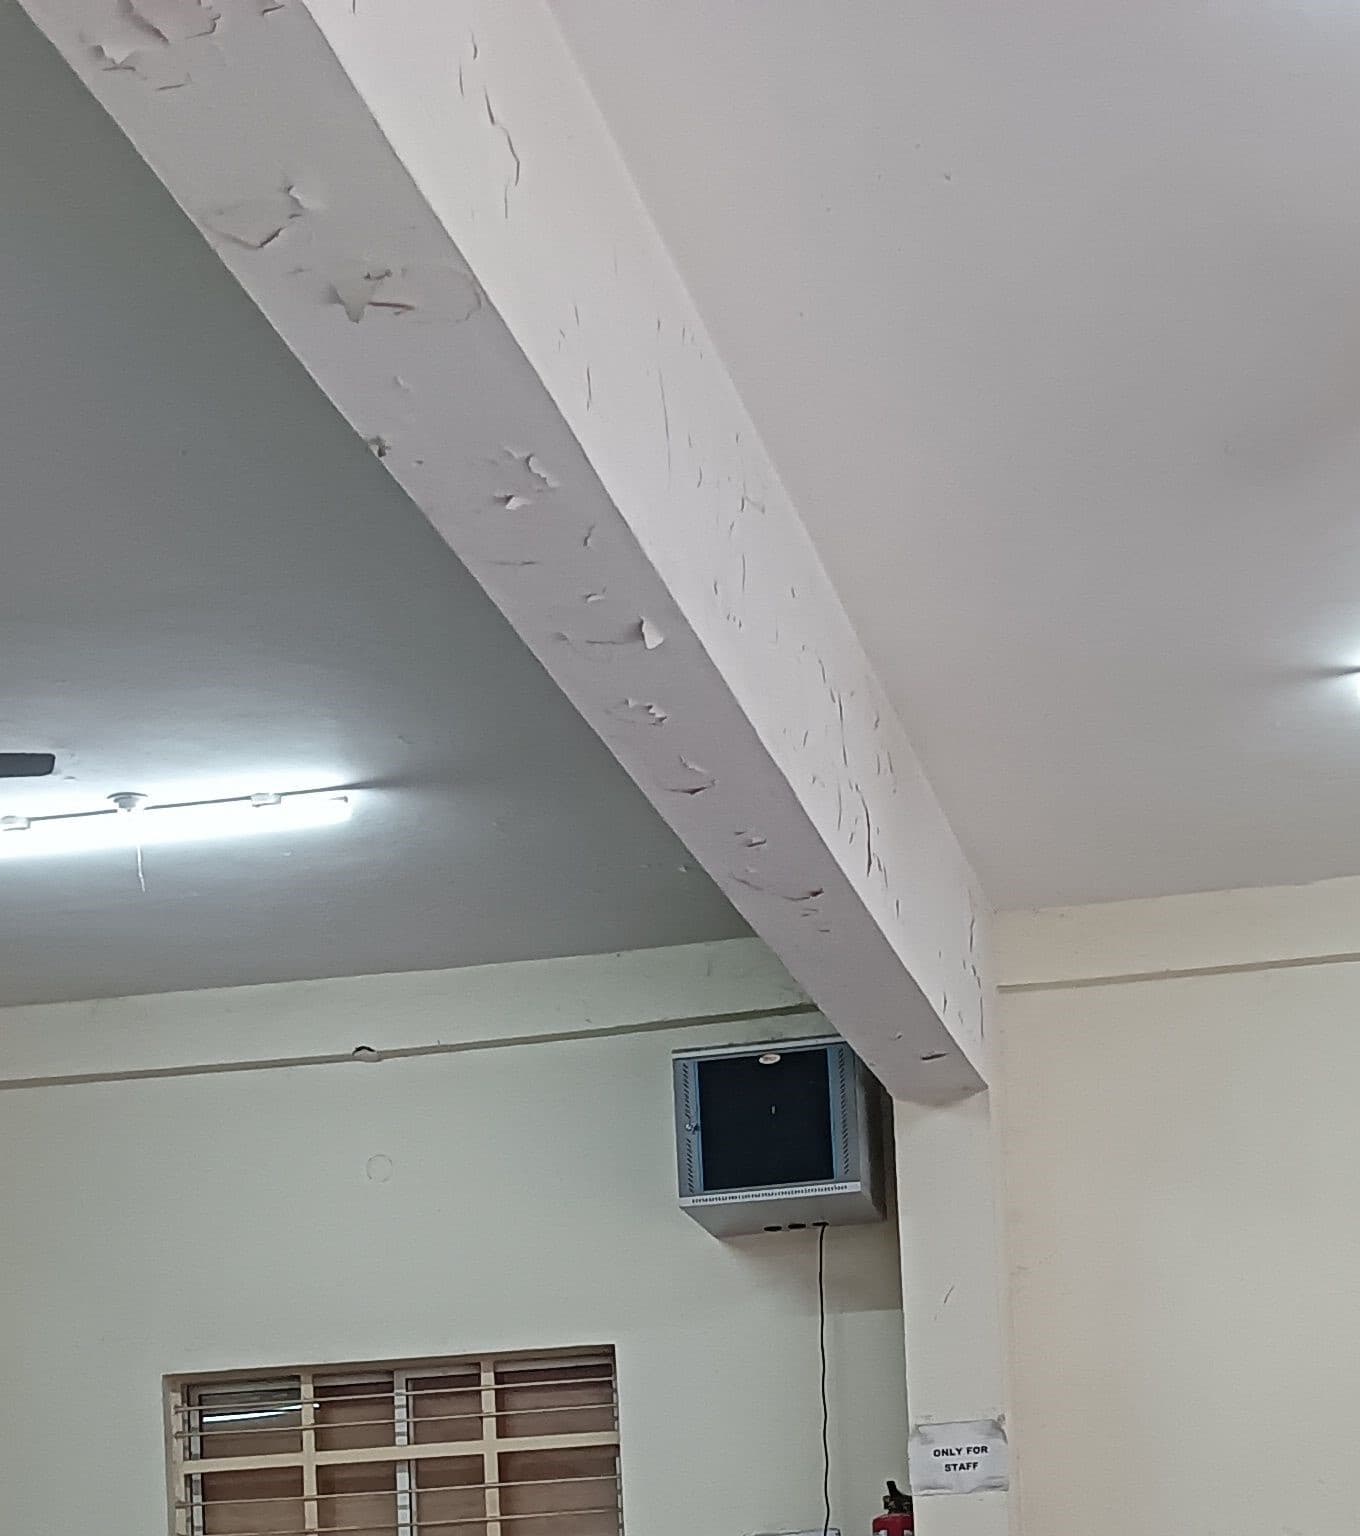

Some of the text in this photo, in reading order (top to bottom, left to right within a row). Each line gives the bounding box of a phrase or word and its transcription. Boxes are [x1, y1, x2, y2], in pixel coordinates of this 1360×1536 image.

[933, 1445, 988, 1457] ONLY FOR
[944, 1462, 978, 1472] STAFF
